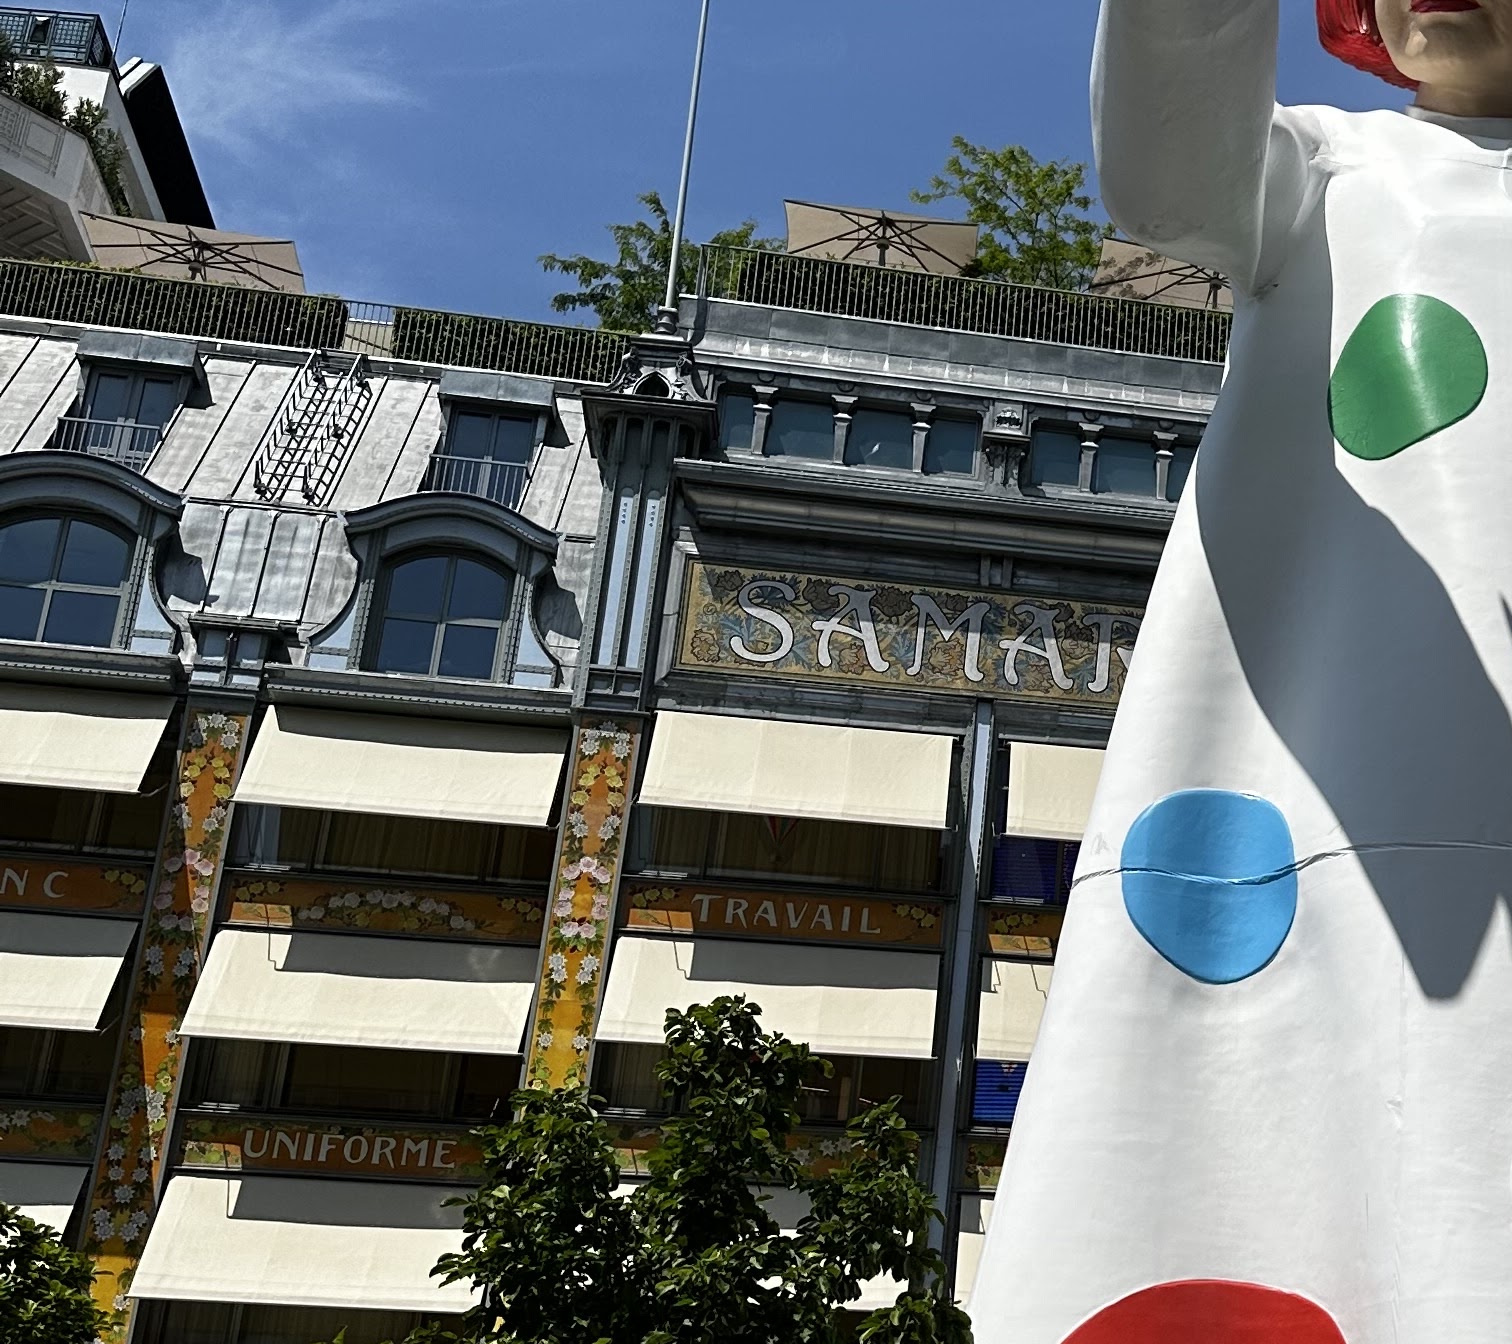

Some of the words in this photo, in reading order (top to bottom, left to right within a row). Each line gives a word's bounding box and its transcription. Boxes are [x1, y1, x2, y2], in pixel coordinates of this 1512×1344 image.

[0, 867, 69, 899] NC
[692, 893, 881, 935] TRAVAIL
[243, 1128, 458, 1169] UNIFORME
